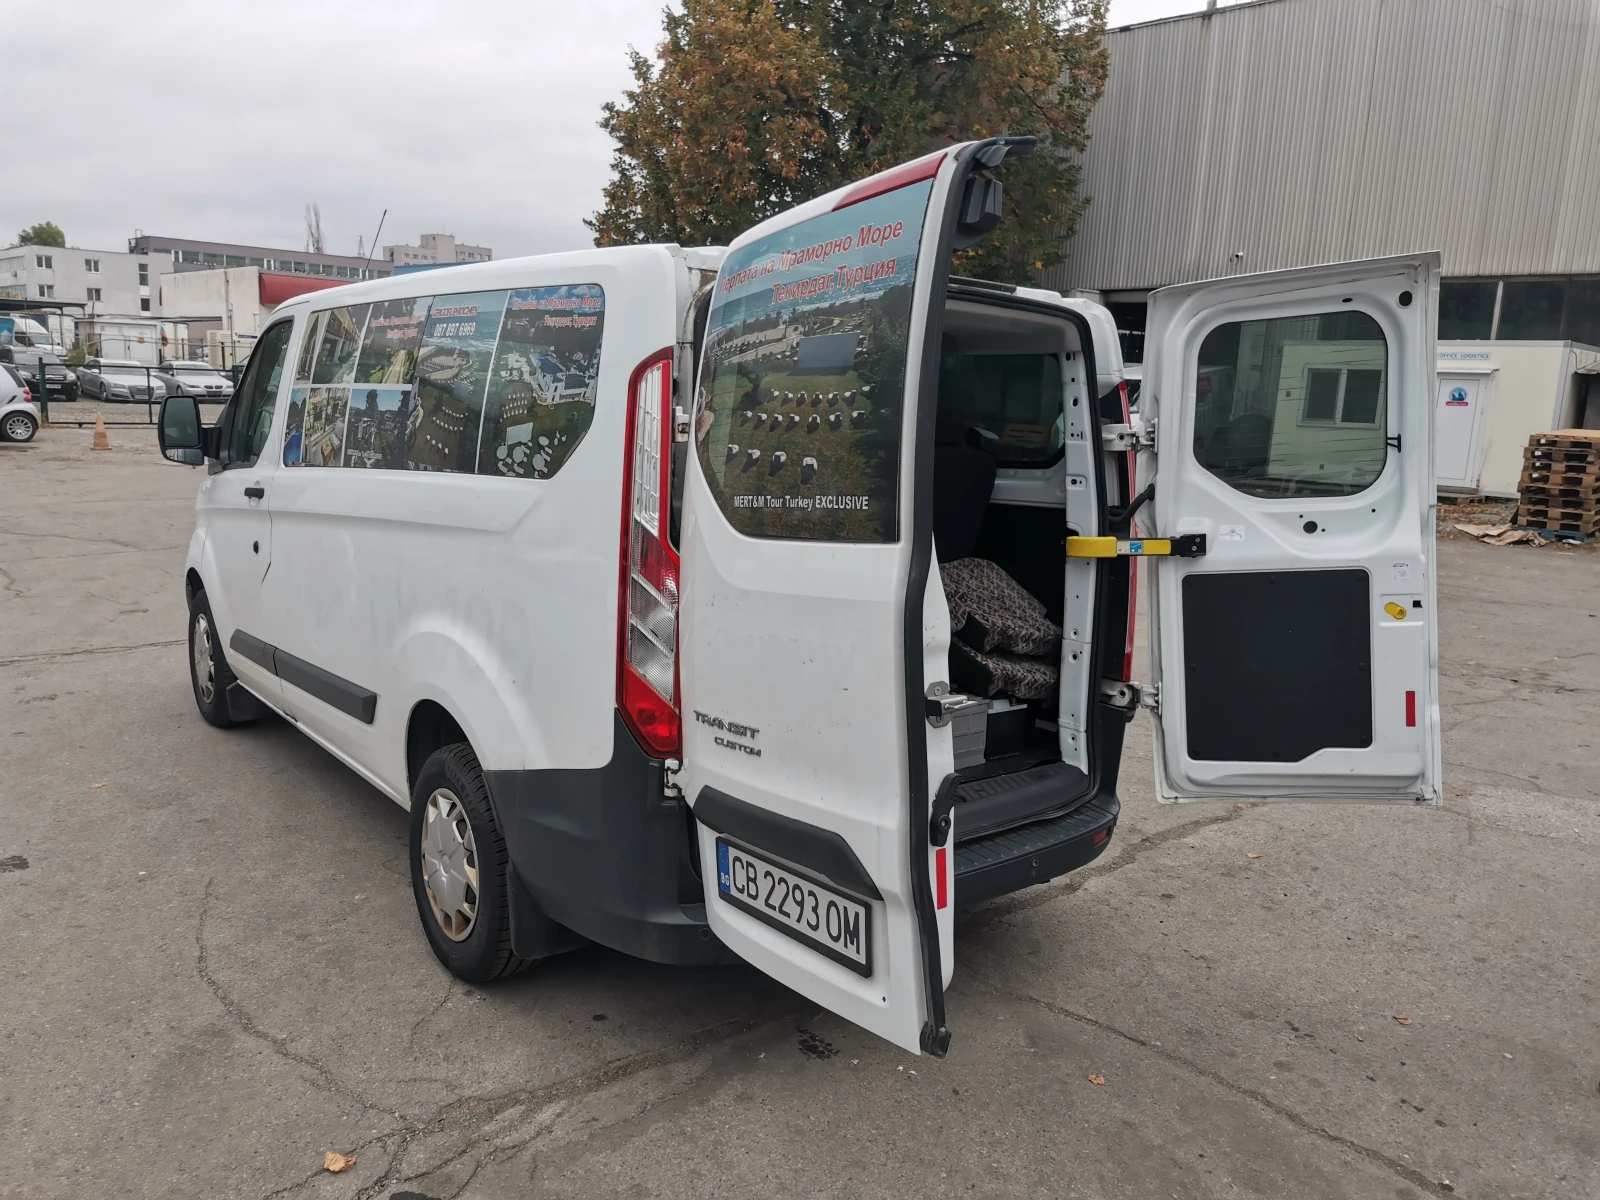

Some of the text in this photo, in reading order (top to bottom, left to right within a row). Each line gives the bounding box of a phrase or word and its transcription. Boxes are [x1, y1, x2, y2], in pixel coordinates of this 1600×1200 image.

[719, 220, 904, 295] Перлата на Мраморно Море
[771, 257, 897, 305] Текирдаг, Турция
[582, 295, 602, 309] Море
[434, 323, 446, 336] 087
[446, 322, 459, 336] 897
[733, 495, 869, 511] MERT&M Tour Turkey EXCLUSIVE
[693, 710, 760, 740] TRANSIT
[714, 736, 761, 758] CUSTOM
[720, 871, 730, 886] BG
[732, 856, 860, 955] CB 2293 OM
